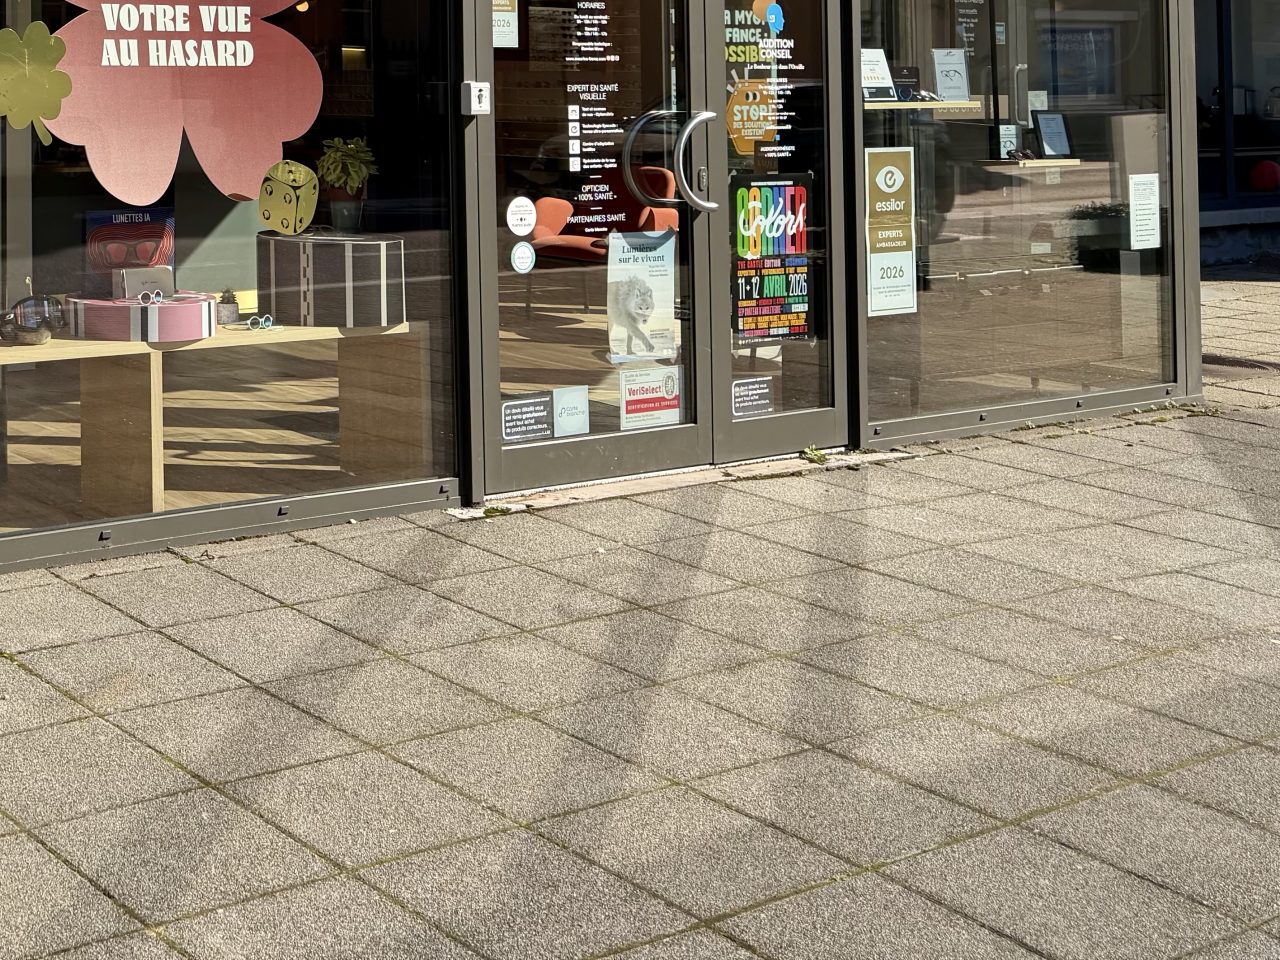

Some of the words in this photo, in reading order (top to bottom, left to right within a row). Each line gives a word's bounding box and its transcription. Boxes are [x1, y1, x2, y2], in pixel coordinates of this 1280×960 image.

[577, 1, 606, 9] HORAIRES
[101, 3, 190, 33] VOTRE
[198, 5, 252, 33] VUE
[758, 38, 795, 49] AUDITION
[101, 39, 140, 67] AU
[147, 40, 255, 67] HASARD
[760, 49, 793, 59] CONSEIL
[567, 84, 589, 92] EXPERT
[590, 84, 599, 92] EN
[599, 82, 619, 92] SANTÉ
[579, 92, 607, 100] VISUELLE
[581, 184, 609, 192] OPTICIEN
[578, 193, 594, 201] 100%
[594, 190, 614, 200] SANTÉ
[875, 199, 906, 212] essilor
[112, 213, 143, 223] LUNETTES
[144, 212, 151, 222] IA
[566, 214, 606, 223] PARTENAIRES
[606, 212, 627, 222] SANTÉ
[878, 229, 903, 239] EXPERTS
[632, 254, 640, 263] le
[640, 254, 665, 263] vivant
[879, 265, 905, 280] 2026
[737, 277, 746, 300] 11
[751, 276, 760, 299] 12
[763, 274, 788, 298] AVRIL
[788, 273, 808, 296] 2026
[627, 384, 662, 397] VeriSelect
